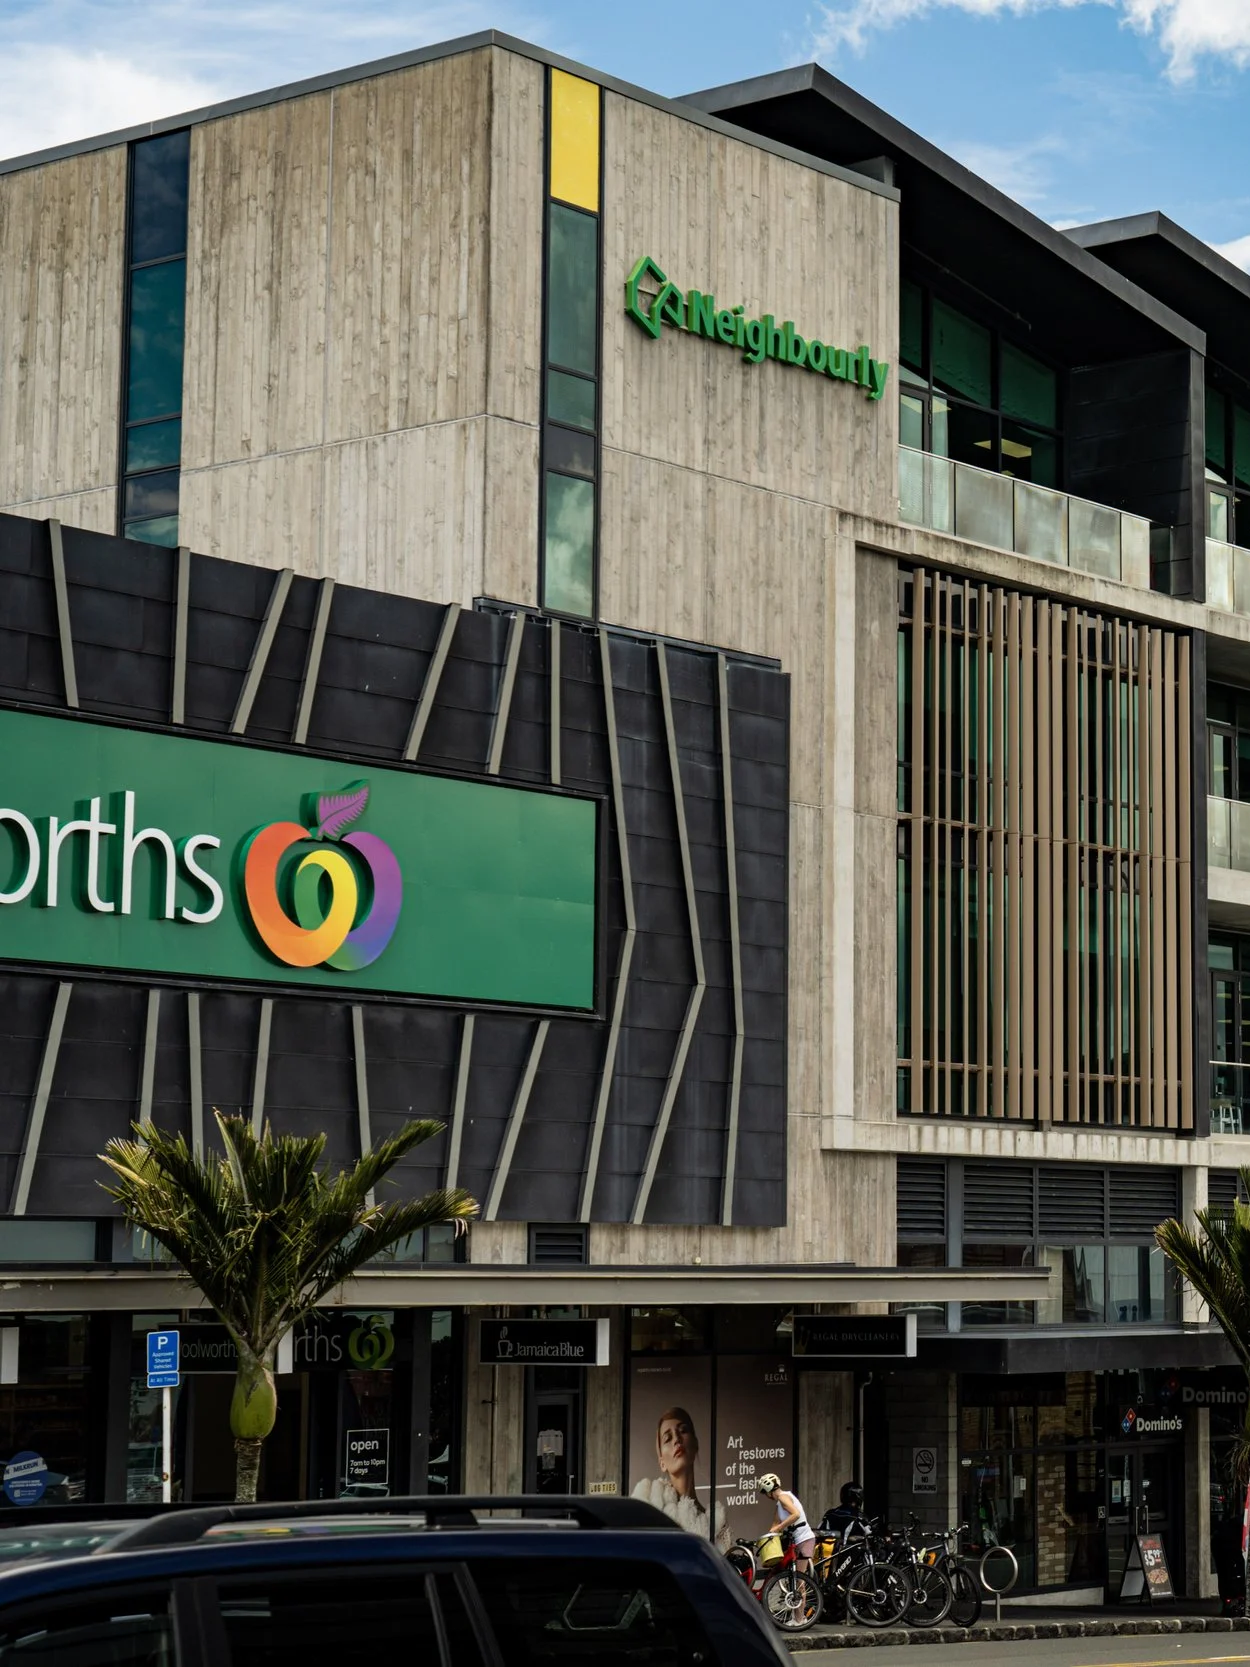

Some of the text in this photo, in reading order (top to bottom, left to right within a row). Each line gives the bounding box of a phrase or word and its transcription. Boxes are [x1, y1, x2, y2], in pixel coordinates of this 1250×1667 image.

[687, 289, 889, 400] Neighbourly
[157, 1336, 169, 1350] P
[764, 1373, 788, 1382] REGAL
[1181, 1385, 1249, 1404] Domino'
[1136, 1414, 1183, 1432] Domino's
[350, 1440, 380, 1453] open
[727, 1435, 744, 1449] Art
[739, 1447, 785, 1460] restorers
[725, 1462, 756, 1476] of the
[739, 1476, 761, 1490] fash
[726, 1491, 758, 1506] world.
